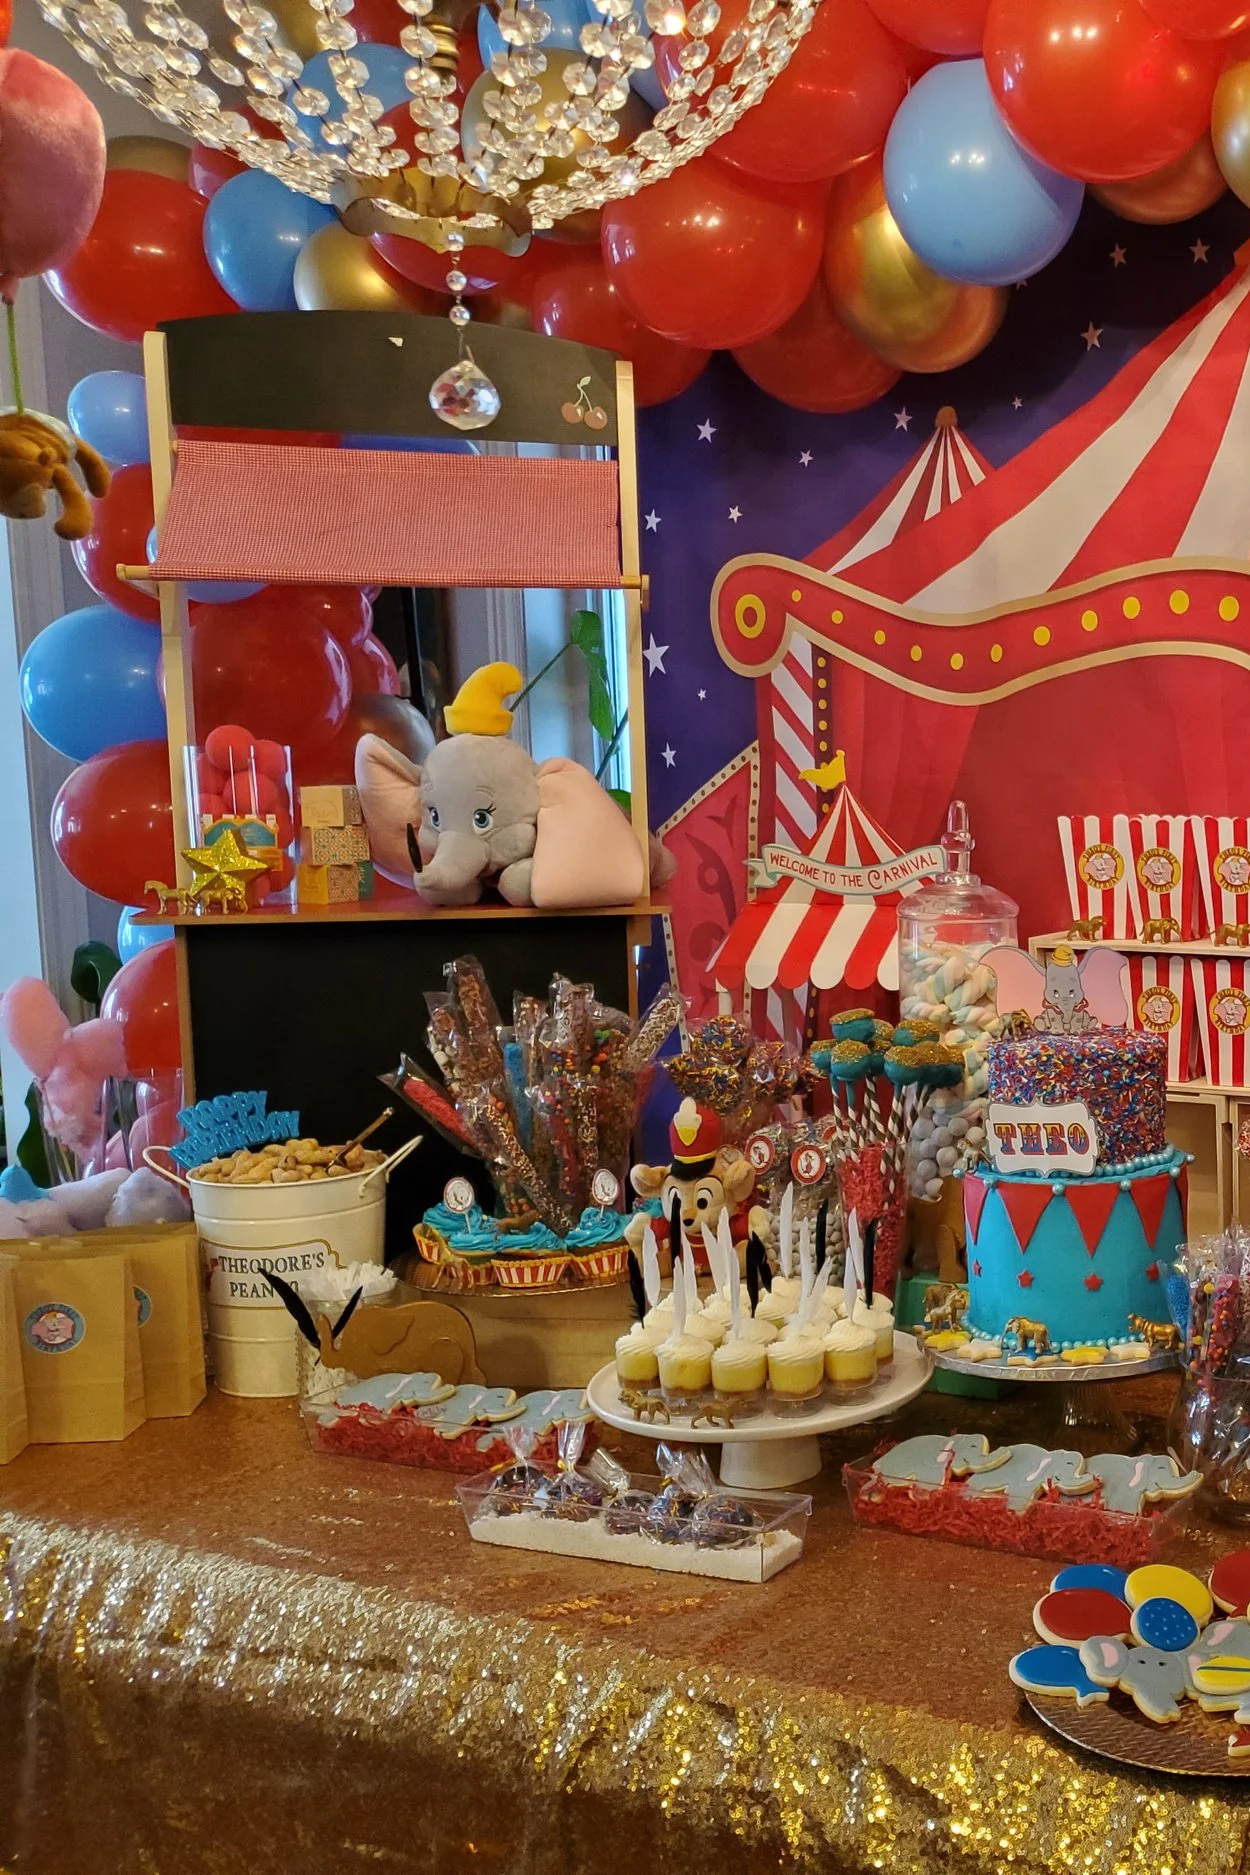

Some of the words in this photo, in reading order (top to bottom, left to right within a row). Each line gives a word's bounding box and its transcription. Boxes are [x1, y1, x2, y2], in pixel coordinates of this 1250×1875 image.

[770, 851, 820, 880] WELCOME
[822, 870, 836, 885] TO
[840, 874, 864, 888] THE
[867, 852, 937, 890] CARNIVAL
[992, 1122, 1090, 1156] THEO
[218, 1251, 326, 1274] THEODORE'S
